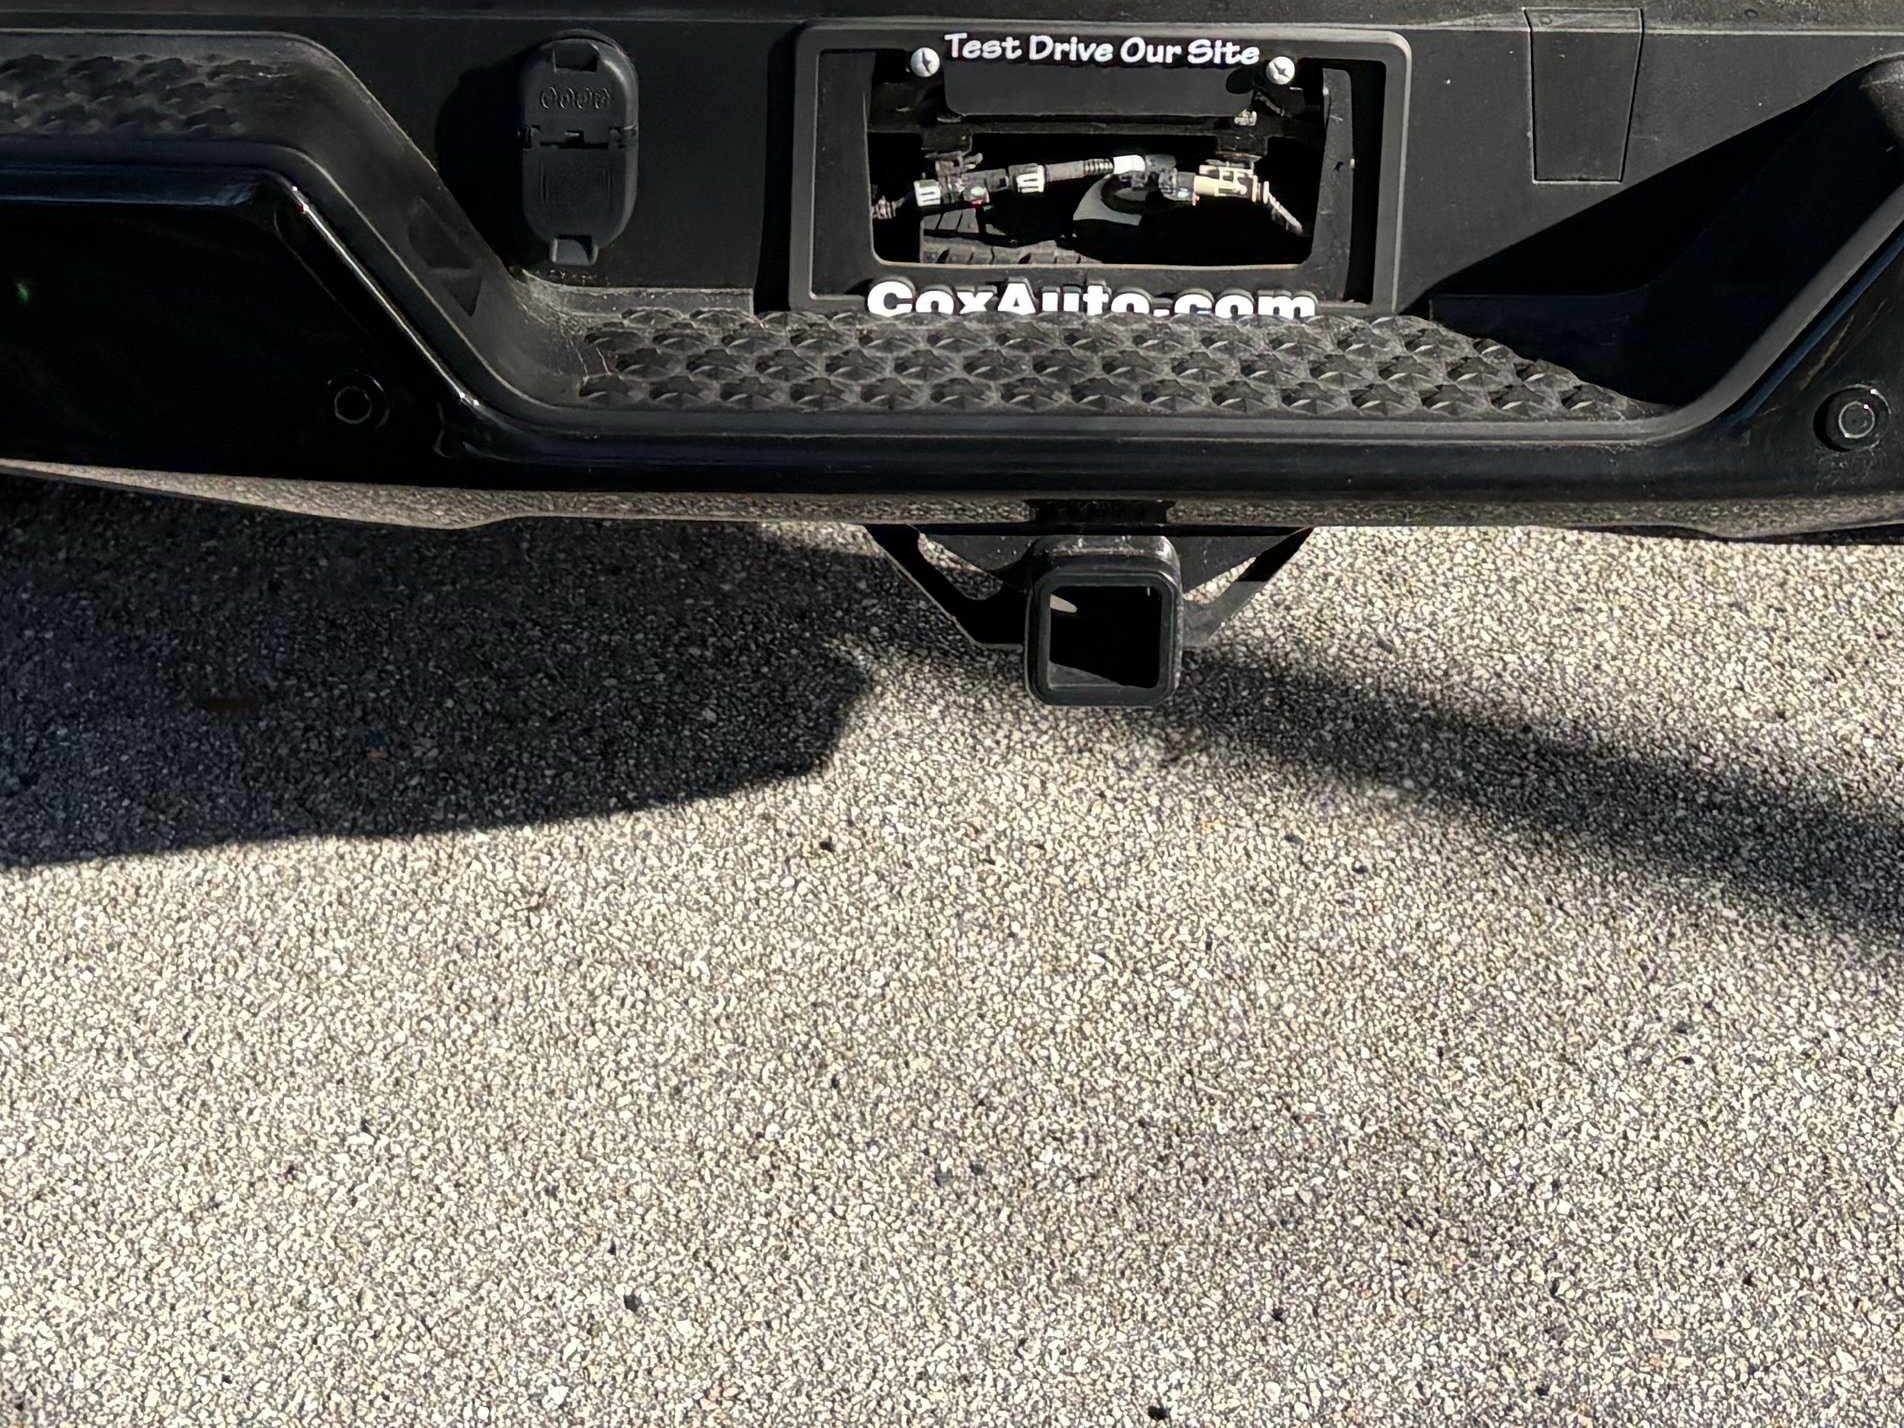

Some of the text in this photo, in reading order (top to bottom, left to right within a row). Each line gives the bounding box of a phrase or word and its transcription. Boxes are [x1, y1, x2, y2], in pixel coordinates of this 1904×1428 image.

[944, 33, 1260, 65] Test Drive Our Site
[866, 281, 1317, 318] CoxAuto.com
